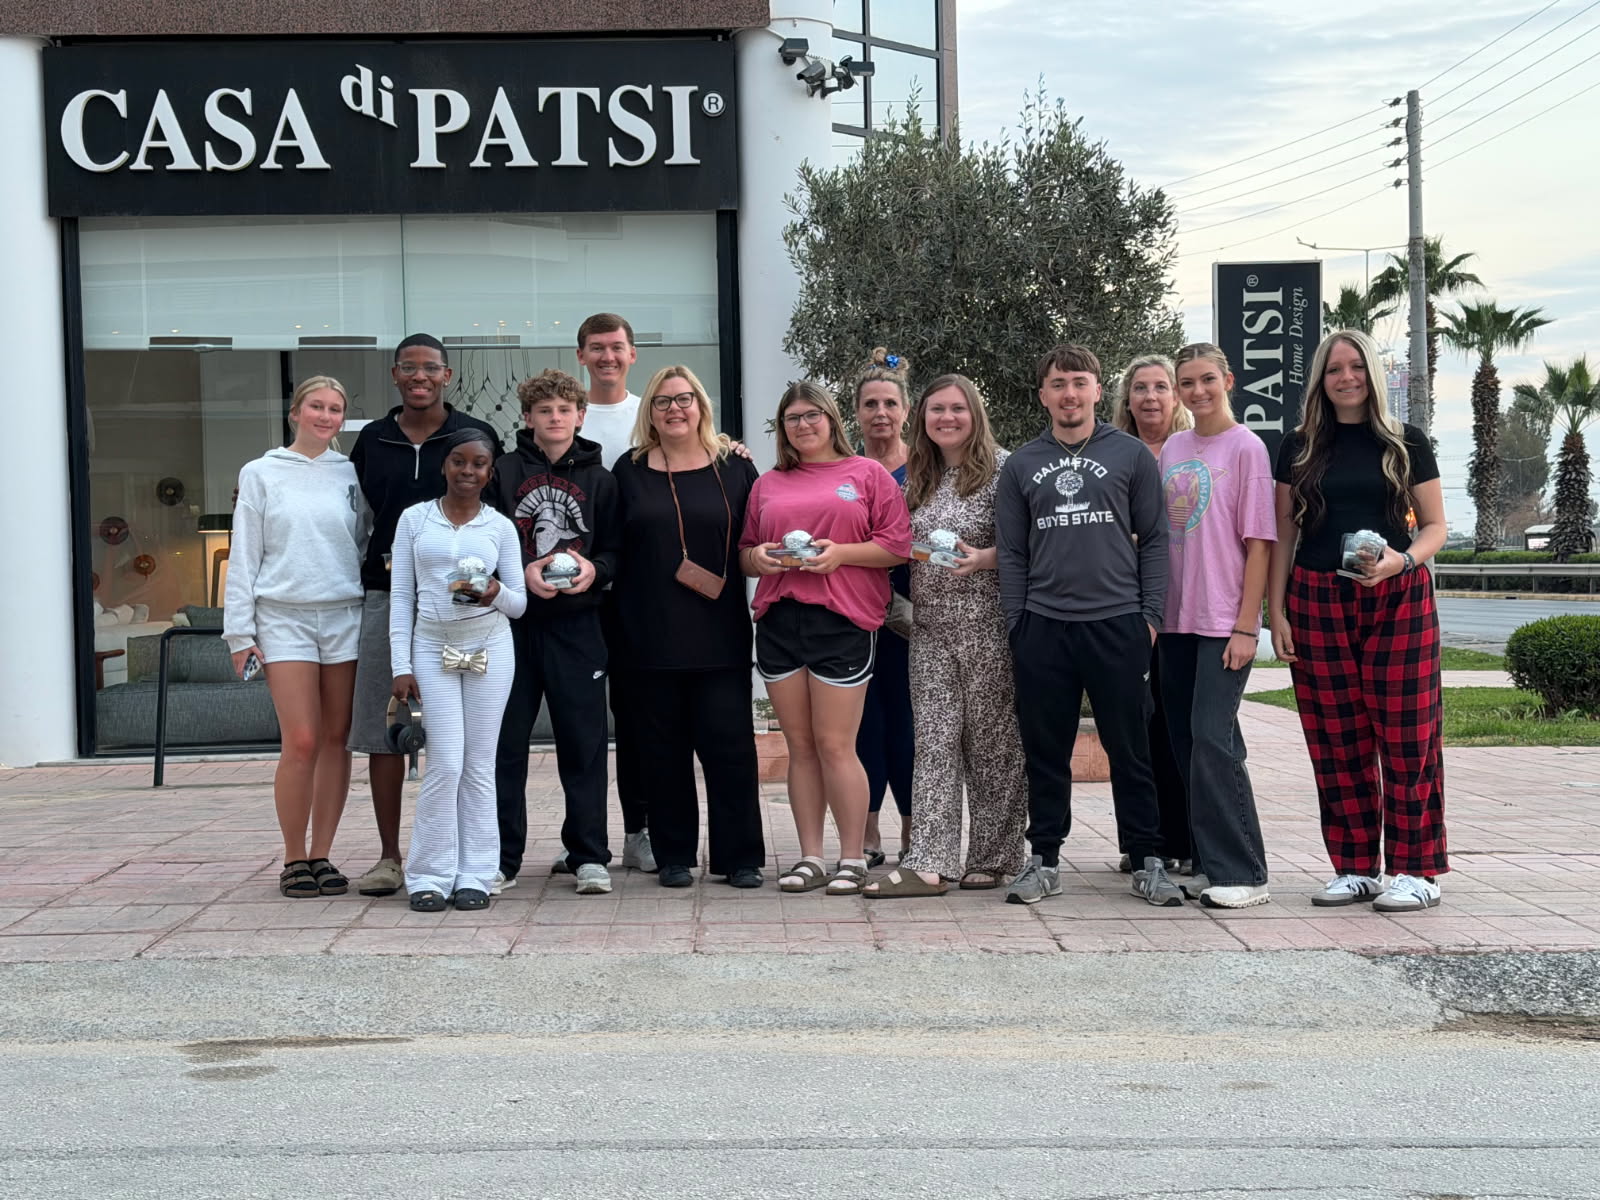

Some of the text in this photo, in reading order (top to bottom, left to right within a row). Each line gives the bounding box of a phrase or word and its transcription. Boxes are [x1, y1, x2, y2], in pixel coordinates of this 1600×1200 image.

[60, 87, 331, 173] CASA
[340, 63, 398, 128] di
[1288, 286, 1308, 386] Home Design
[1032, 457, 1108, 485] PALMETTO
[1036, 510, 1114, 530] BOYS STATE
